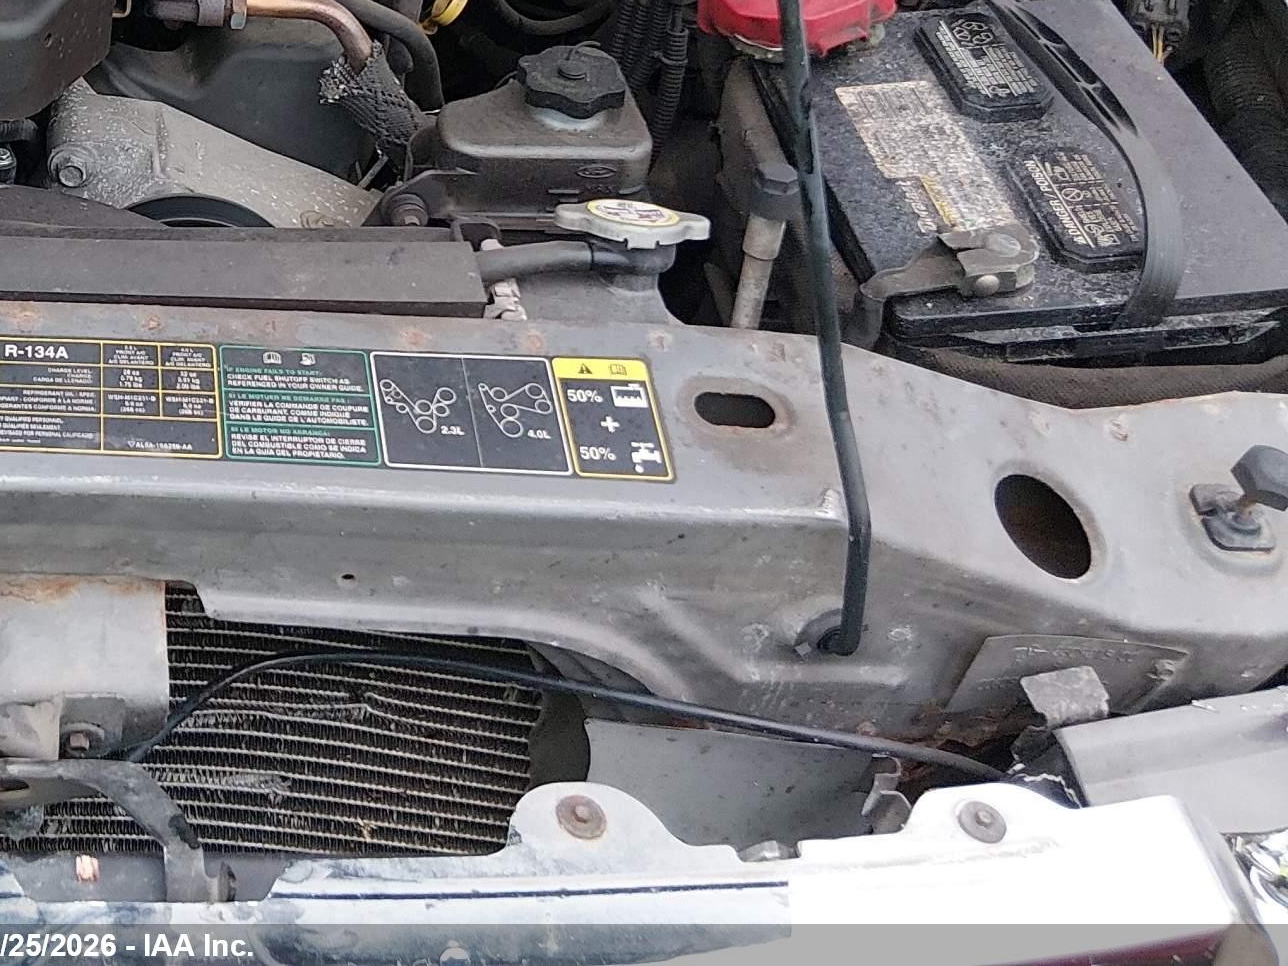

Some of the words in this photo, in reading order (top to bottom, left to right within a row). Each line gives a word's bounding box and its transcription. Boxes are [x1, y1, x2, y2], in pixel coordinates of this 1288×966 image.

[1024, 160, 1052, 192] POISON
[1049, 199, 1082, 236] DANGER
[4, 344, 69, 360] R-134A
[227, 379, 277, 387] REFERENCED
[309, 383, 338, 391] OWNER
[566, 389, 603, 403] 50%
[274, 402, 318, 410] COMMANDE
[332, 405, 369, 413] COUPURE
[440, 425, 465, 436] 2.3L
[527, 428, 552, 439] 4.0L
[270, 435, 324, 444] INTERRUPTOR
[247, 441, 302, 449] COMBUSTIBLE
[303, 443, 327, 451] COMO
[275, 449, 292, 457] DEL
[579, 446, 617, 461] 50%
